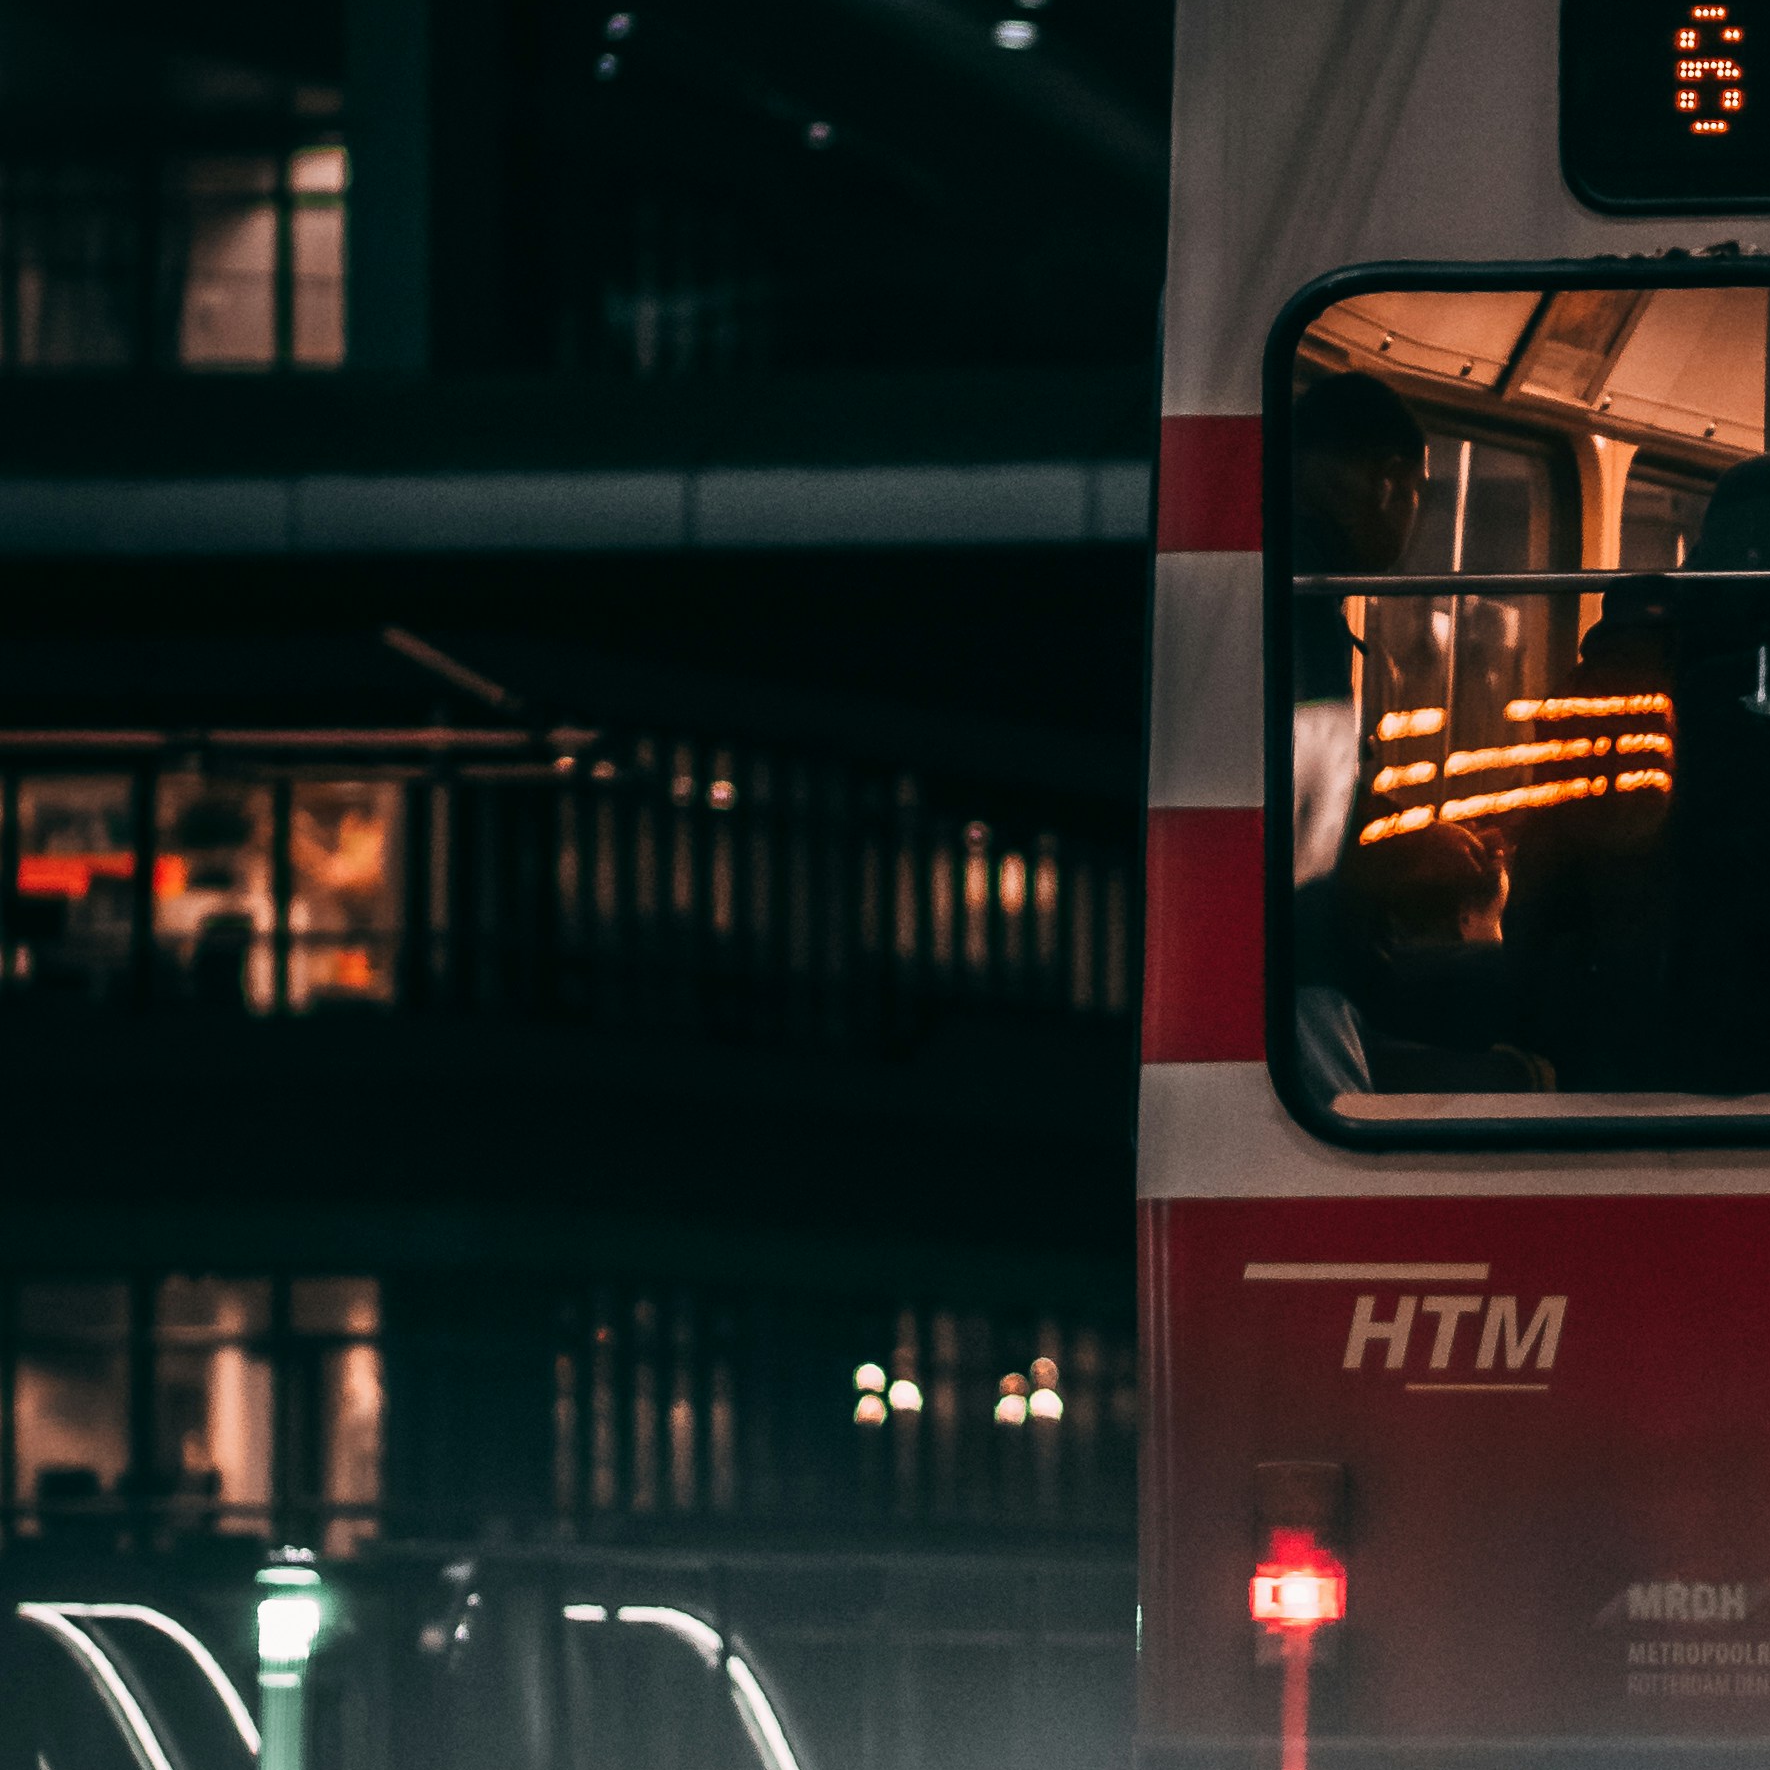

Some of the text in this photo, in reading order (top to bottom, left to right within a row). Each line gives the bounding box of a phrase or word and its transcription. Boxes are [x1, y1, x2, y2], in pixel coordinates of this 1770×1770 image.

[1674, 5, 1743, 134] 6
[1343, 1294, 1569, 1370] HTM
[1627, 1582, 1747, 1621] MRDH
